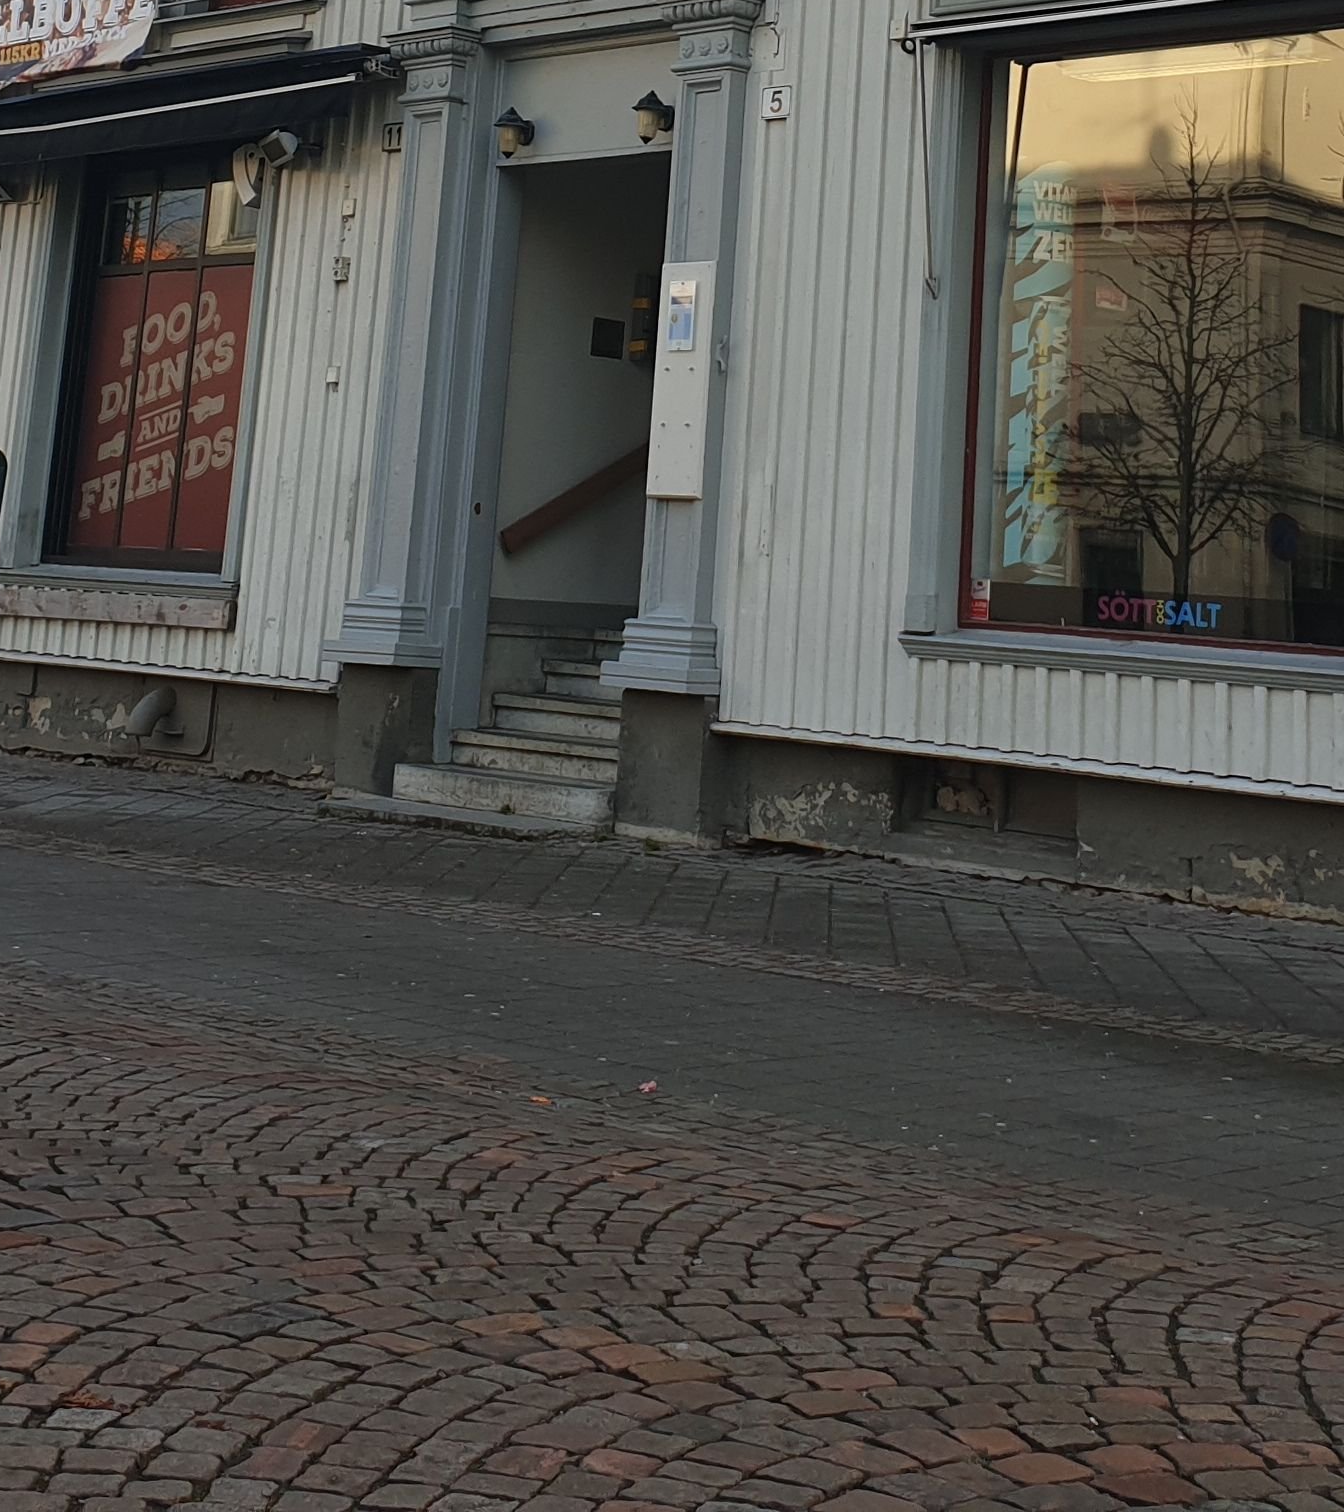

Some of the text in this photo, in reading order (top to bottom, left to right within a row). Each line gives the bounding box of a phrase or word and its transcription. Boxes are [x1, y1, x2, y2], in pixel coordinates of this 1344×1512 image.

[769, 90, 783, 113] 5
[98, 331, 236, 424] DRINKS
[136, 408, 181, 442] AND
[78, 425, 235, 521] FRIENDS
[1098, 589, 1222, 629] SÖTT OCH SALT
